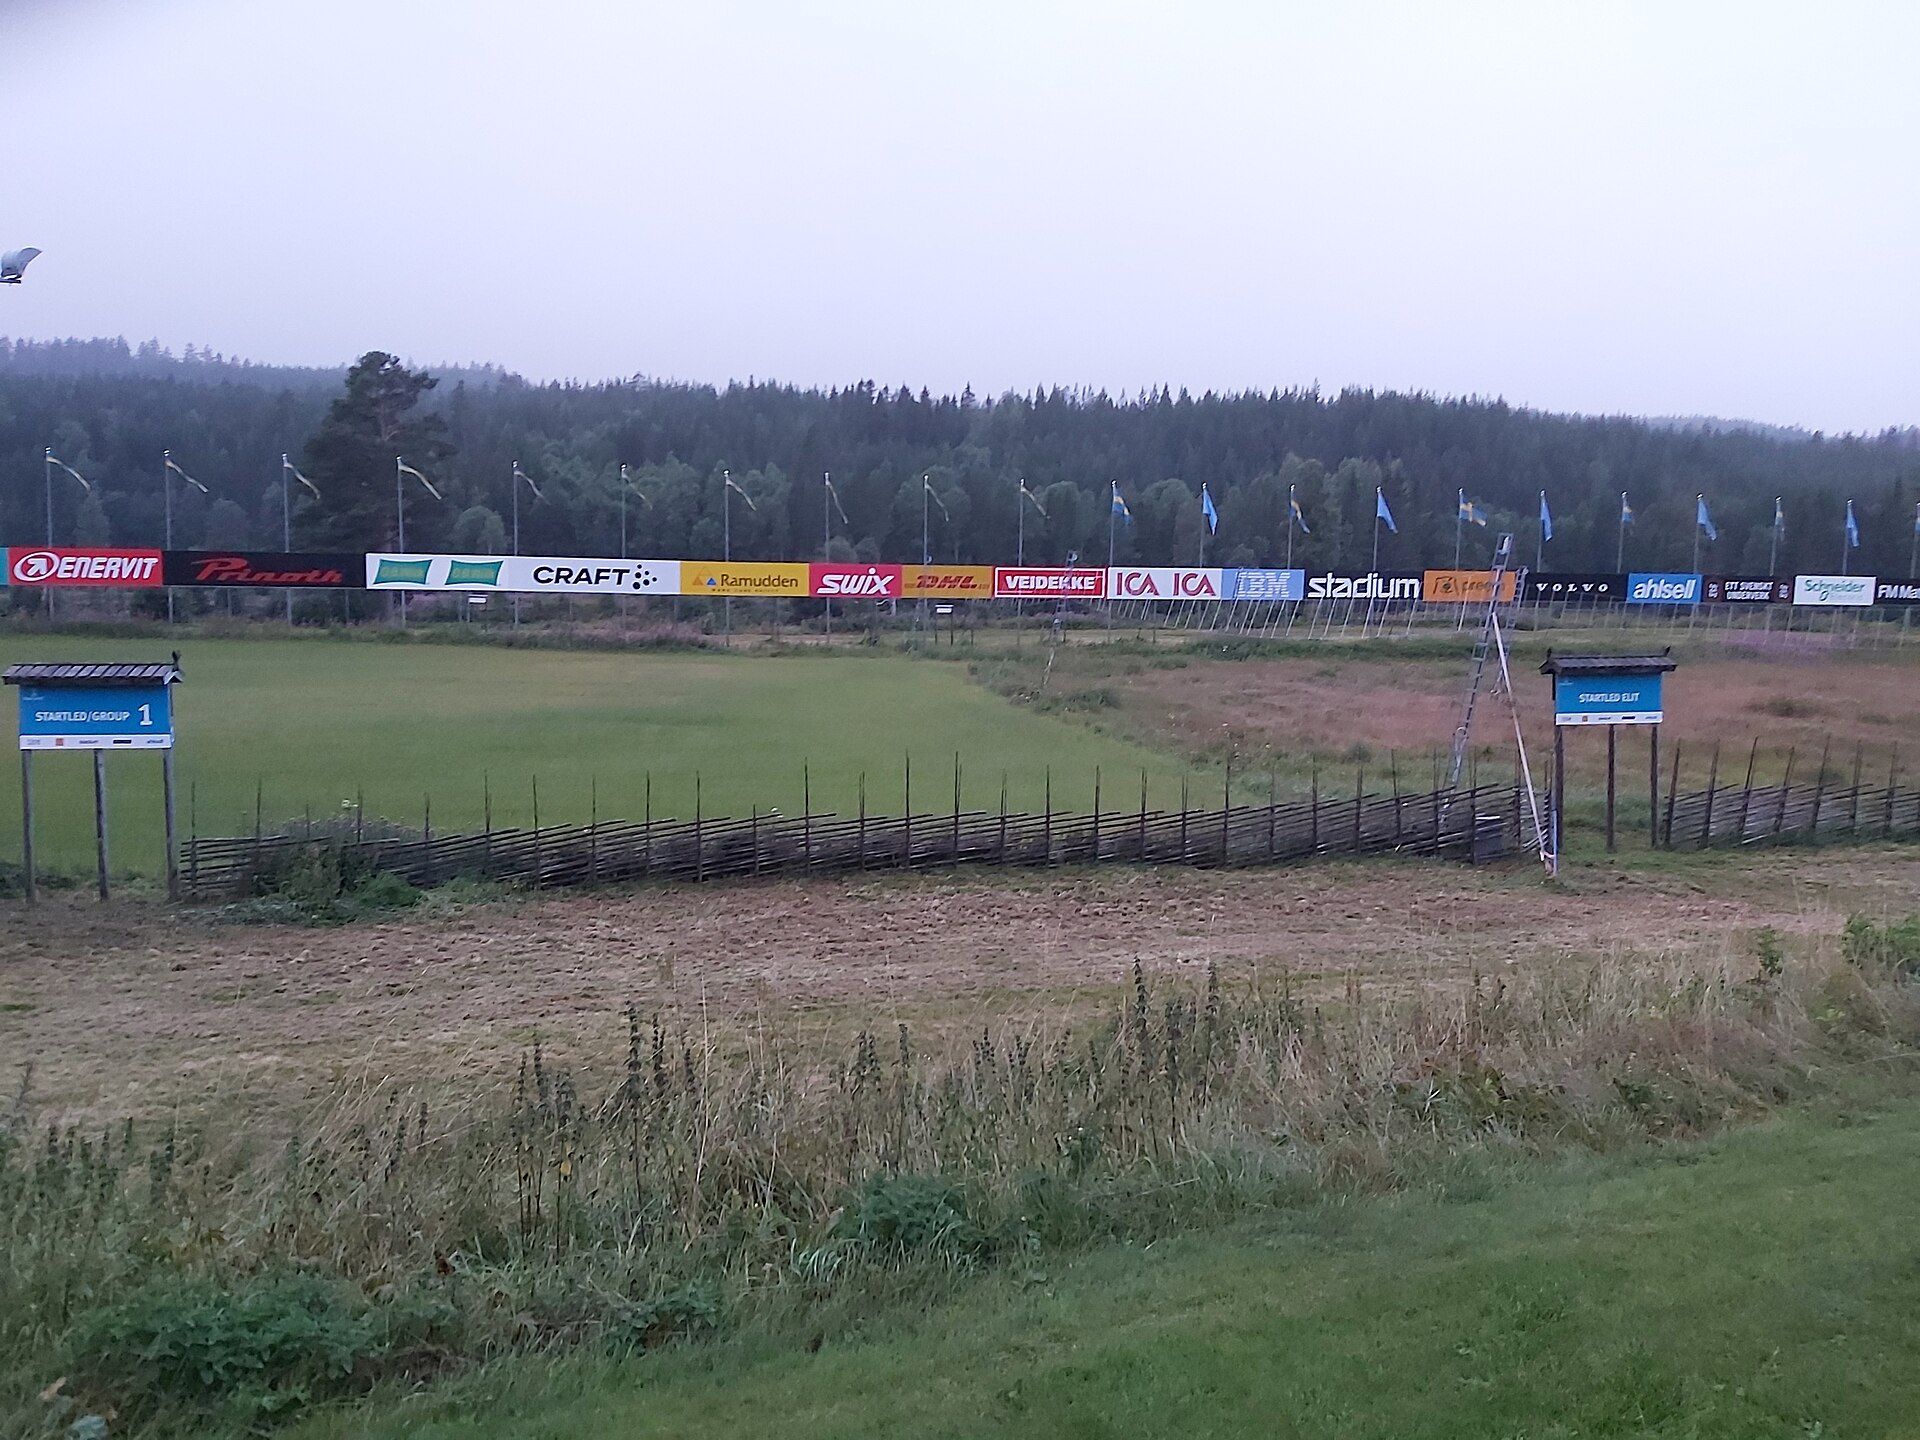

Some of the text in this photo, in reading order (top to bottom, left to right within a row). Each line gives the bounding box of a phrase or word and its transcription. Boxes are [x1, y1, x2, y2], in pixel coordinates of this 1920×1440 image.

[56, 556, 158, 580] ENERVIT
[533, 566, 630, 585] CRAFT
[721, 574, 799, 588] Ramudden
[916, 575, 978, 589] DHL
[1004, 575, 1097, 590] VEIDEKKE
[1116, 572, 1217, 597] ICA ICA
[1236, 571, 1291, 598] IBM
[1307, 572, 1420, 599] stadium
[1535, 582, 1609, 592] VOLVO
[1632, 578, 1697, 599] ahlsell
[1804, 579, 1866, 592] Schneider
[1578, 692, 1621, 703] STARTLED
[137, 703, 153, 726] 1
